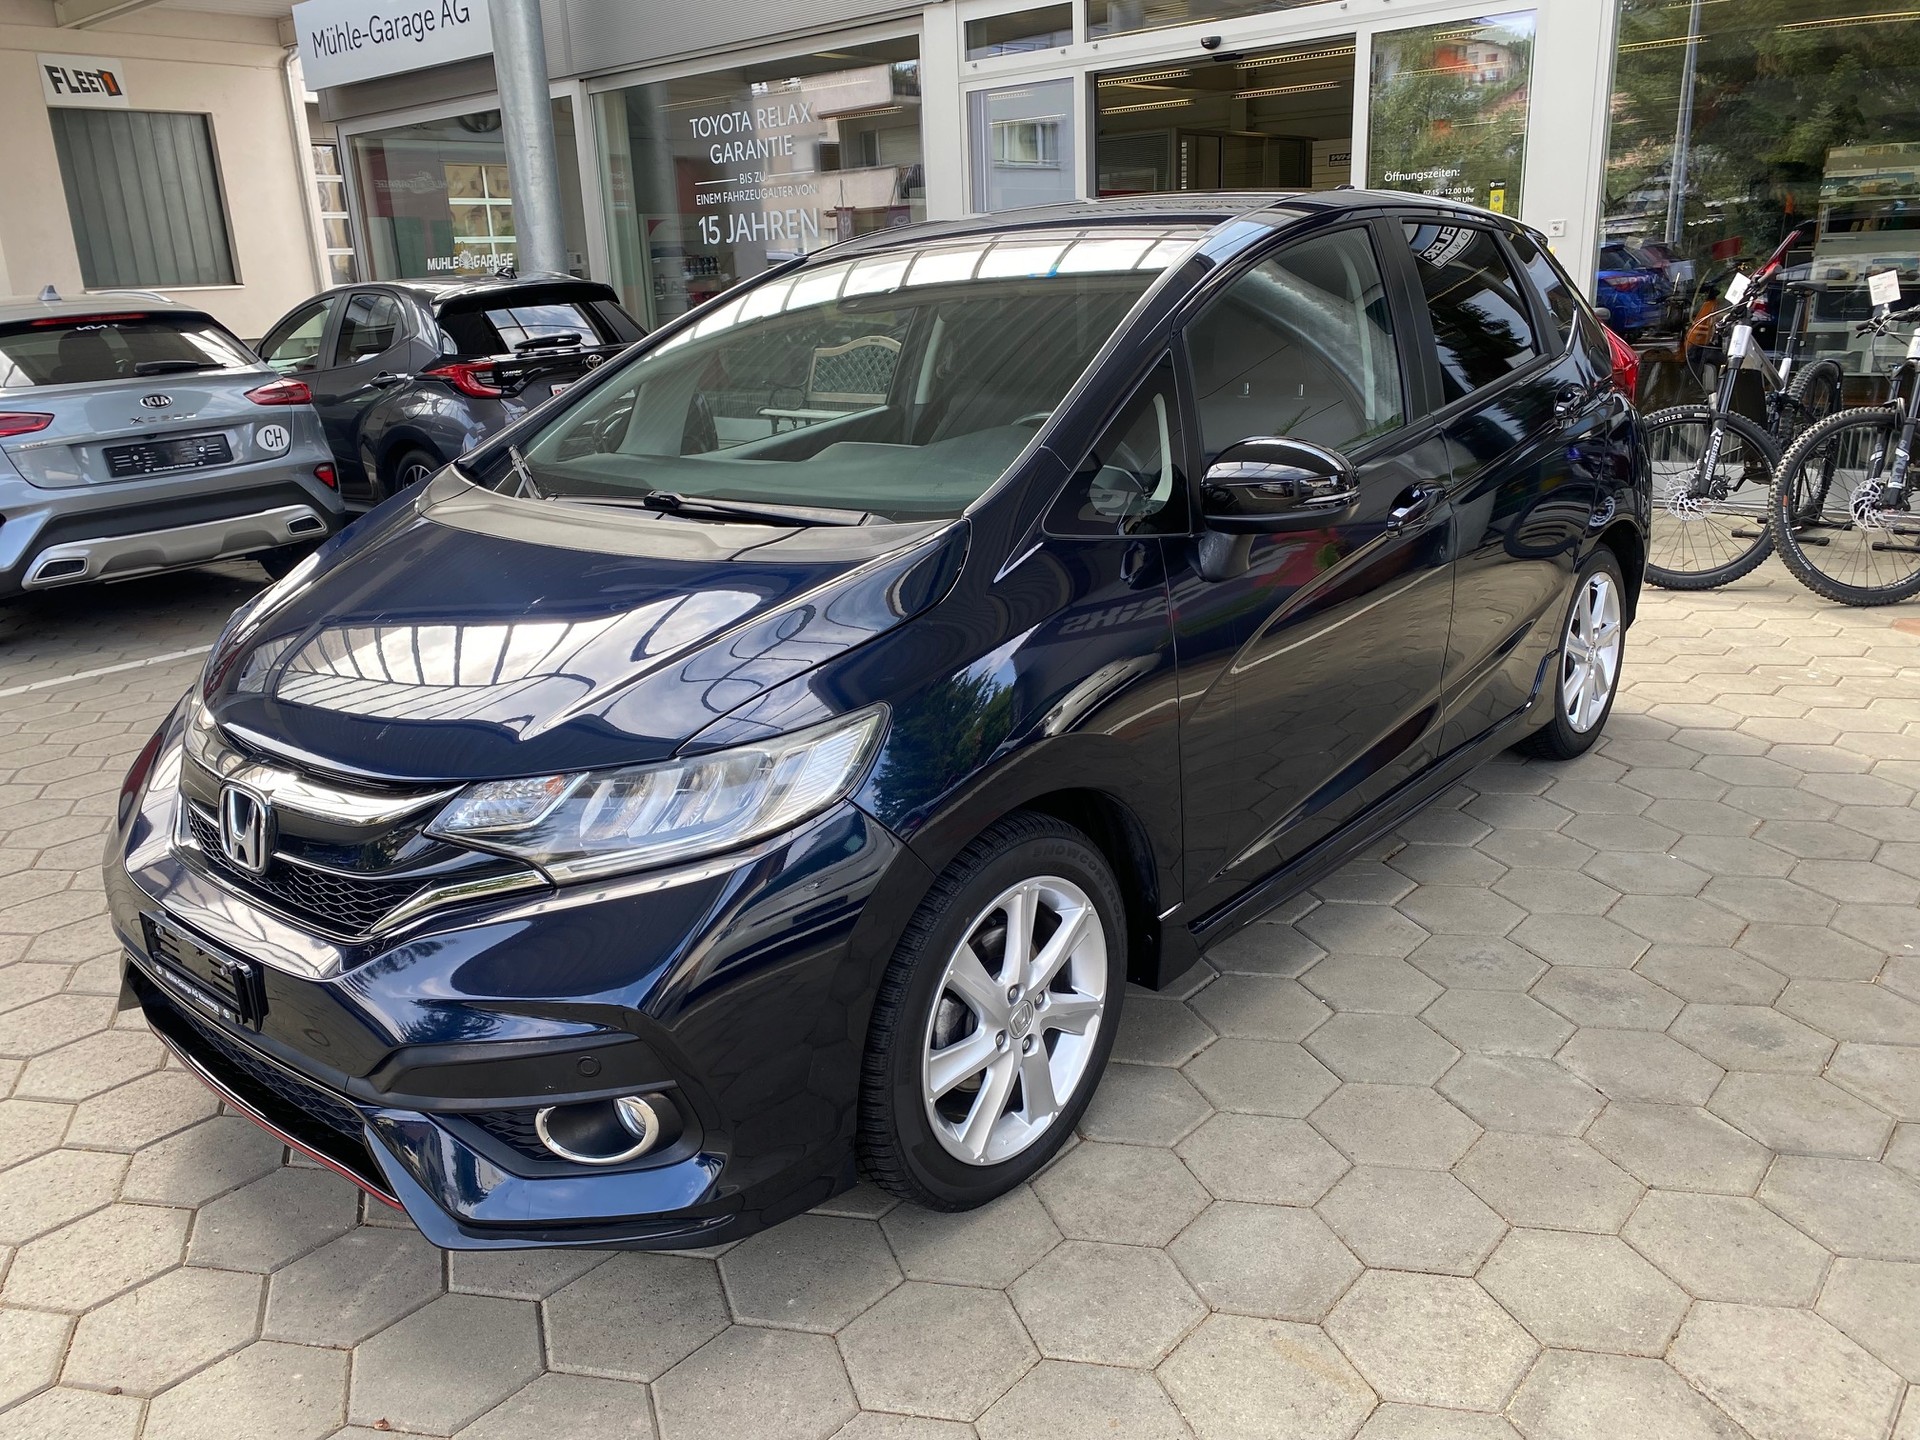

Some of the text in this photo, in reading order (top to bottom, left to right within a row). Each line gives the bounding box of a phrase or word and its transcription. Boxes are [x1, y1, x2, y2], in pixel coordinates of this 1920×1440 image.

[312, 0, 471, 59] Mühle-Garage AG
[689, 101, 812, 139] TOYOTA RELAX
[709, 134, 793, 165] GARANTIE
[739, 171, 766, 185] BIS ZU
[1384, 168, 1461, 182] Öffnungszeiten:
[695, 183, 816, 206] EINEM FAHRZEUGALTER VON
[1445, 187, 1462, 195] 12.00
[1463, 186, 1475, 194] Uhr
[1462, 196, 1475, 204] Uhr
[698, 207, 819, 245] 15 JAHREN
[473, 252, 514, 268] GARAGE
[146, 394, 170, 407] KIA
[1658, 413, 1683, 424] onza
[264, 427, 285, 448] CH
